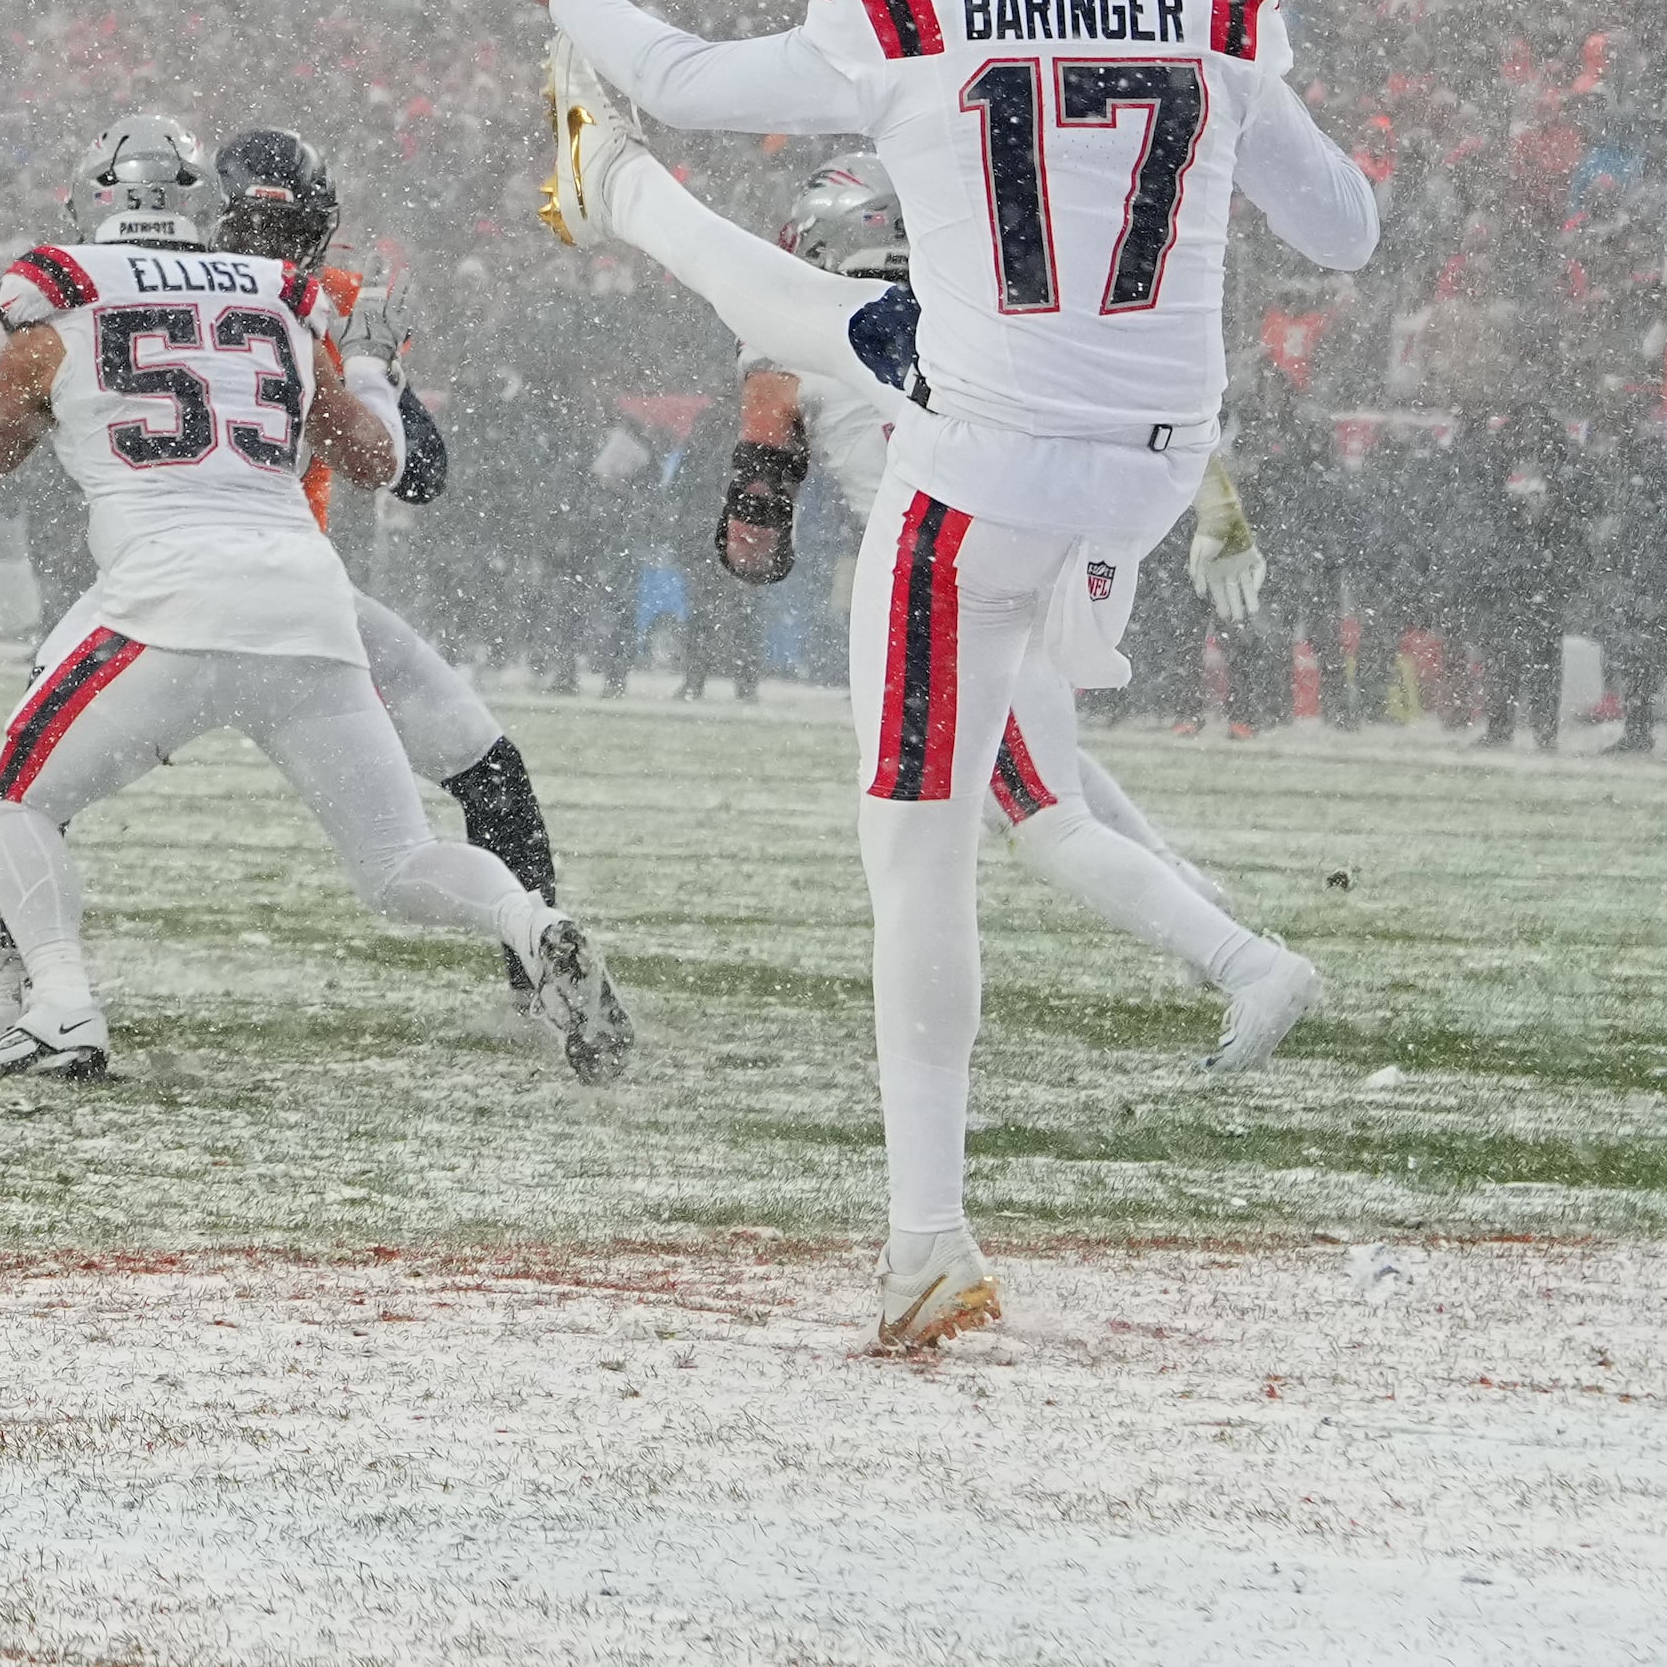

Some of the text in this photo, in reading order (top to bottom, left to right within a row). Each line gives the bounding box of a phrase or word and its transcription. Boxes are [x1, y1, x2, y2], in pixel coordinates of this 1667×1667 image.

[127, 188, 166, 210] 53
[958, 56, 1209, 316] 17
[127, 256, 259, 295] ELLISS
[92, 301, 316, 473] 53
[1088, 575, 1108, 597] NFL
